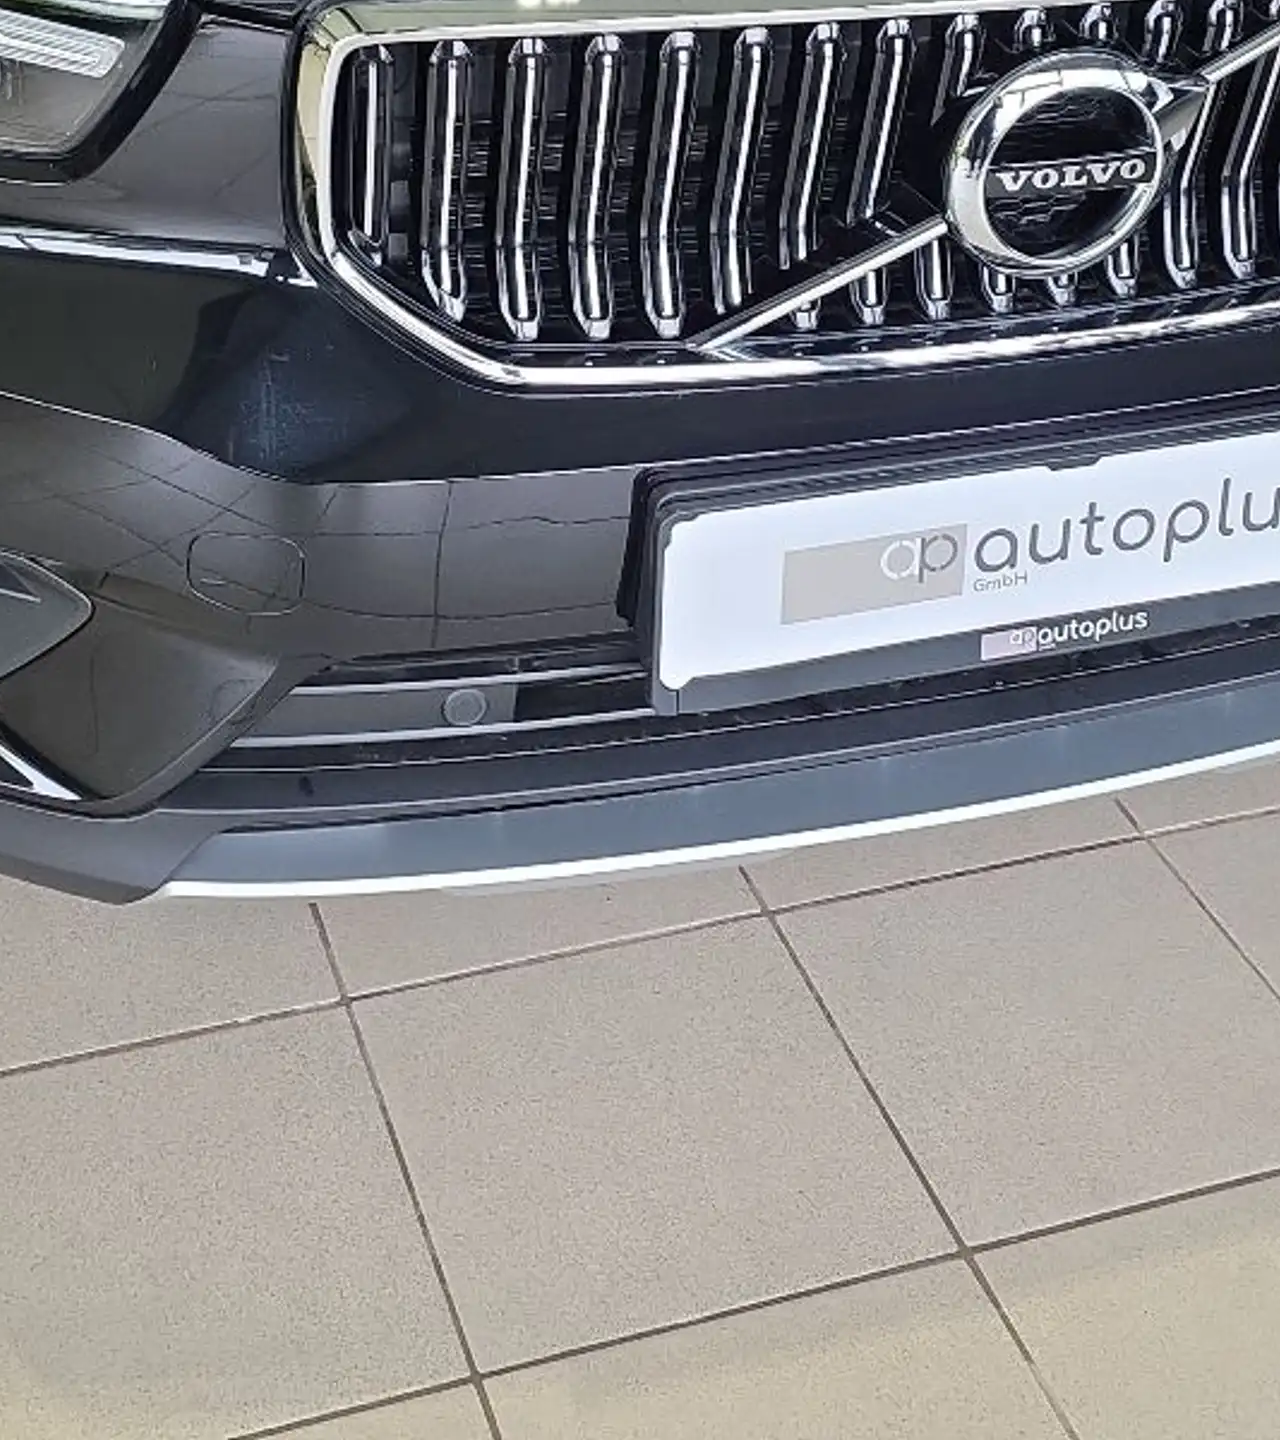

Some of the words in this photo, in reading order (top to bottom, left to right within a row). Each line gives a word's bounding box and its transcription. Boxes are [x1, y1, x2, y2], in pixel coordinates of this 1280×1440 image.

[995, 158, 1146, 191] VOLVO
[973, 572, 1028, 593] GmbH
[1038, 611, 1148, 644] autoplus
